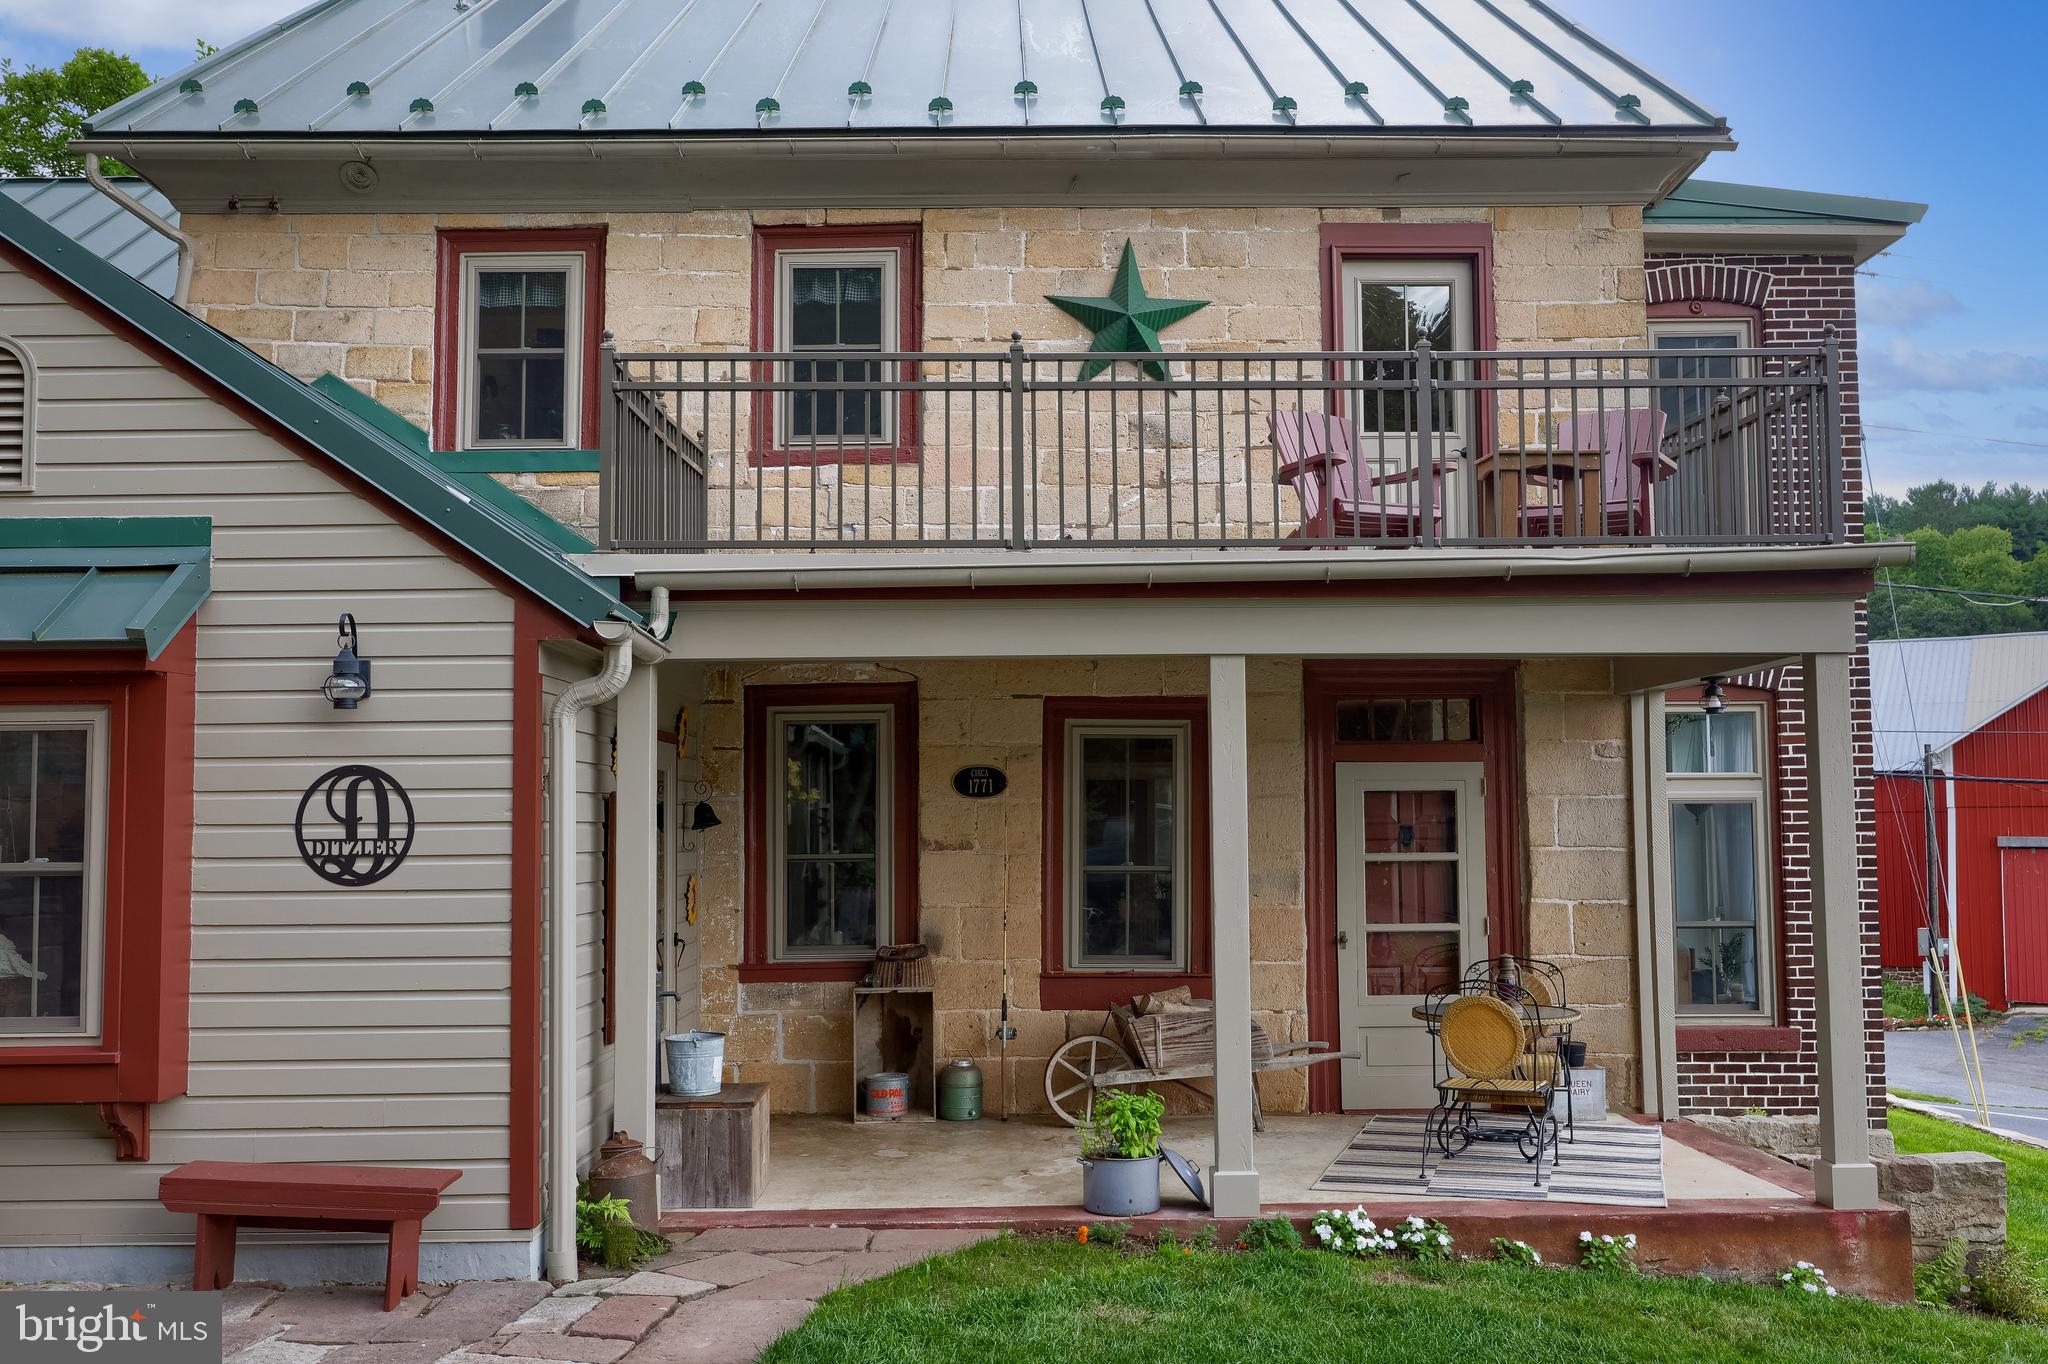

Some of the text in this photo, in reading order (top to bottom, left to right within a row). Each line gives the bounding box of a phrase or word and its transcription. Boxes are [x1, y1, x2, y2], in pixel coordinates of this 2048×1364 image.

[970, 769, 989, 777] CIRCA
[969, 778, 993, 794] 1771
[312, 839, 399, 858] DITZLER
[1567, 1080, 1592, 1088] UEEN
